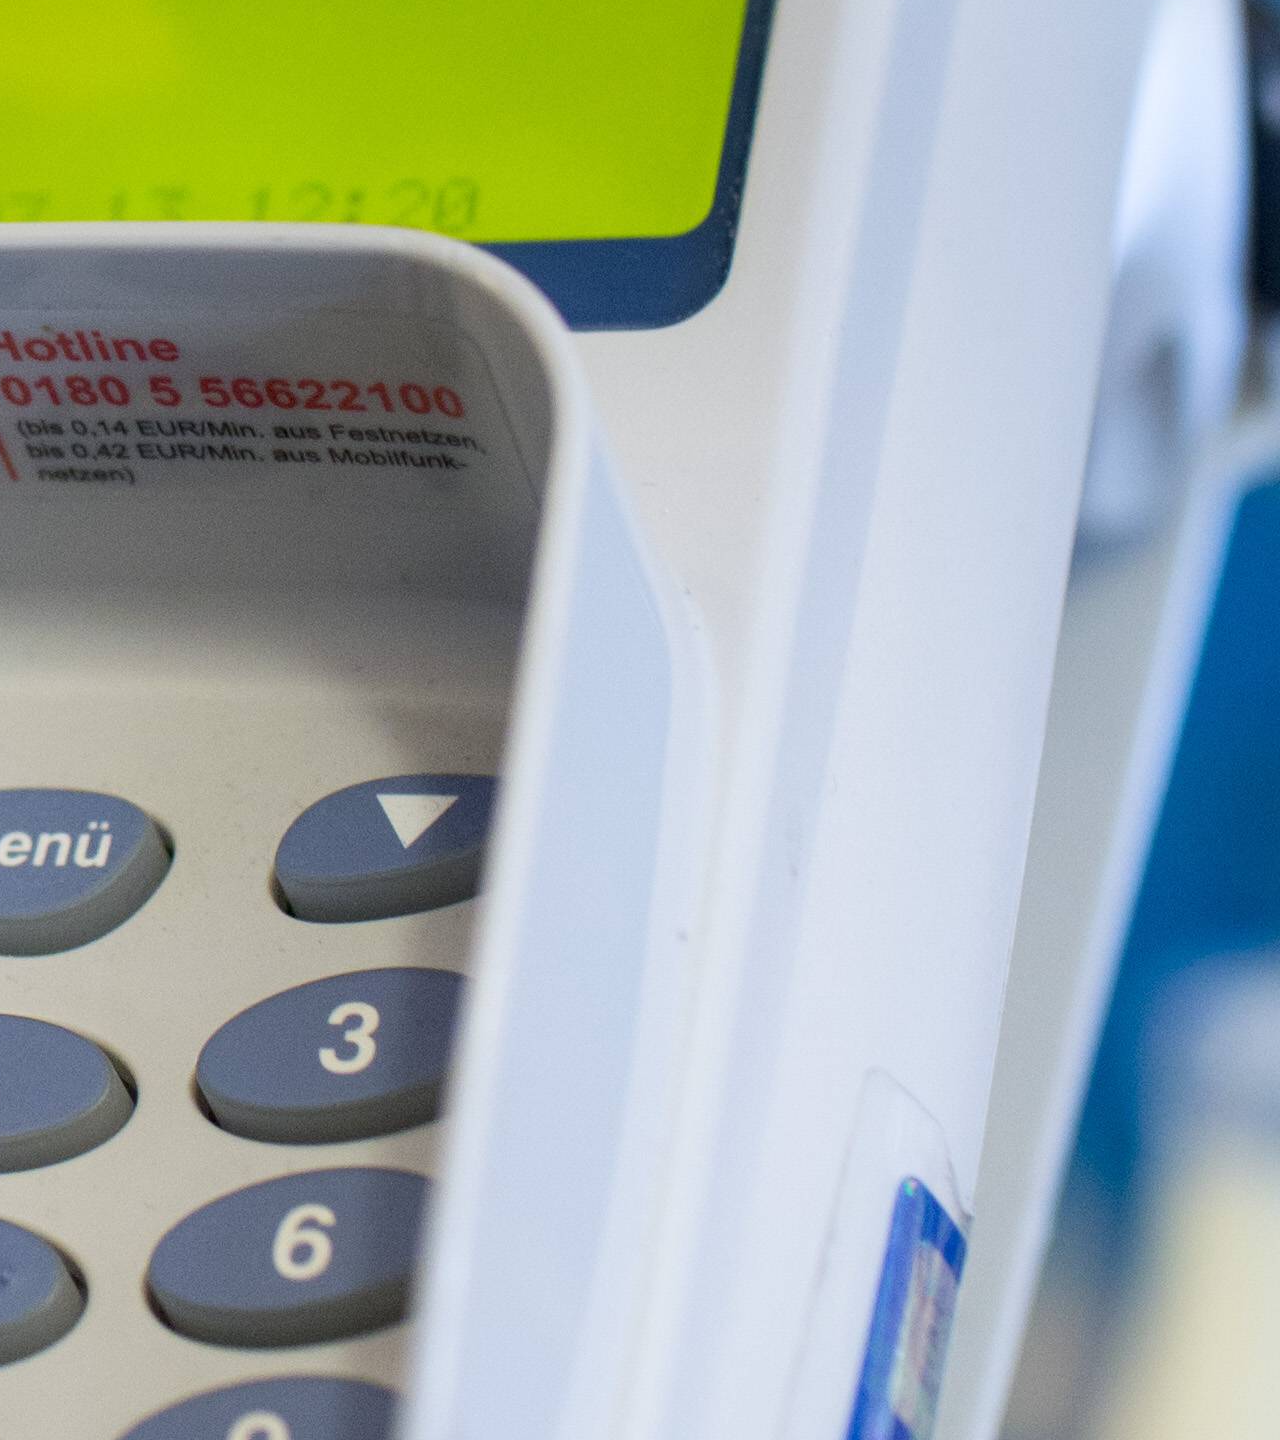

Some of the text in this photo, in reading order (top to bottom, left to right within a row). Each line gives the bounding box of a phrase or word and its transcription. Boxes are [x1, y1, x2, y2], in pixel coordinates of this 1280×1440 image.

[0, 373, 466, 418] 0180 5 56622100
[16, 419, 66, 439] (bis
[71, 419, 131, 439] 0,14
[137, 419, 265, 440] EUR/Min.
[272, 424, 322, 441] aus
[24, 442, 66, 460] bis
[71, 442, 130, 462] 0,42
[136, 442, 265, 463] EUR/Min.
[271, 447, 322, 464] aus
[37, 466, 137, 486] netzen)
[317, 1001, 381, 1076] 3
[272, 1203, 337, 1281] 6
